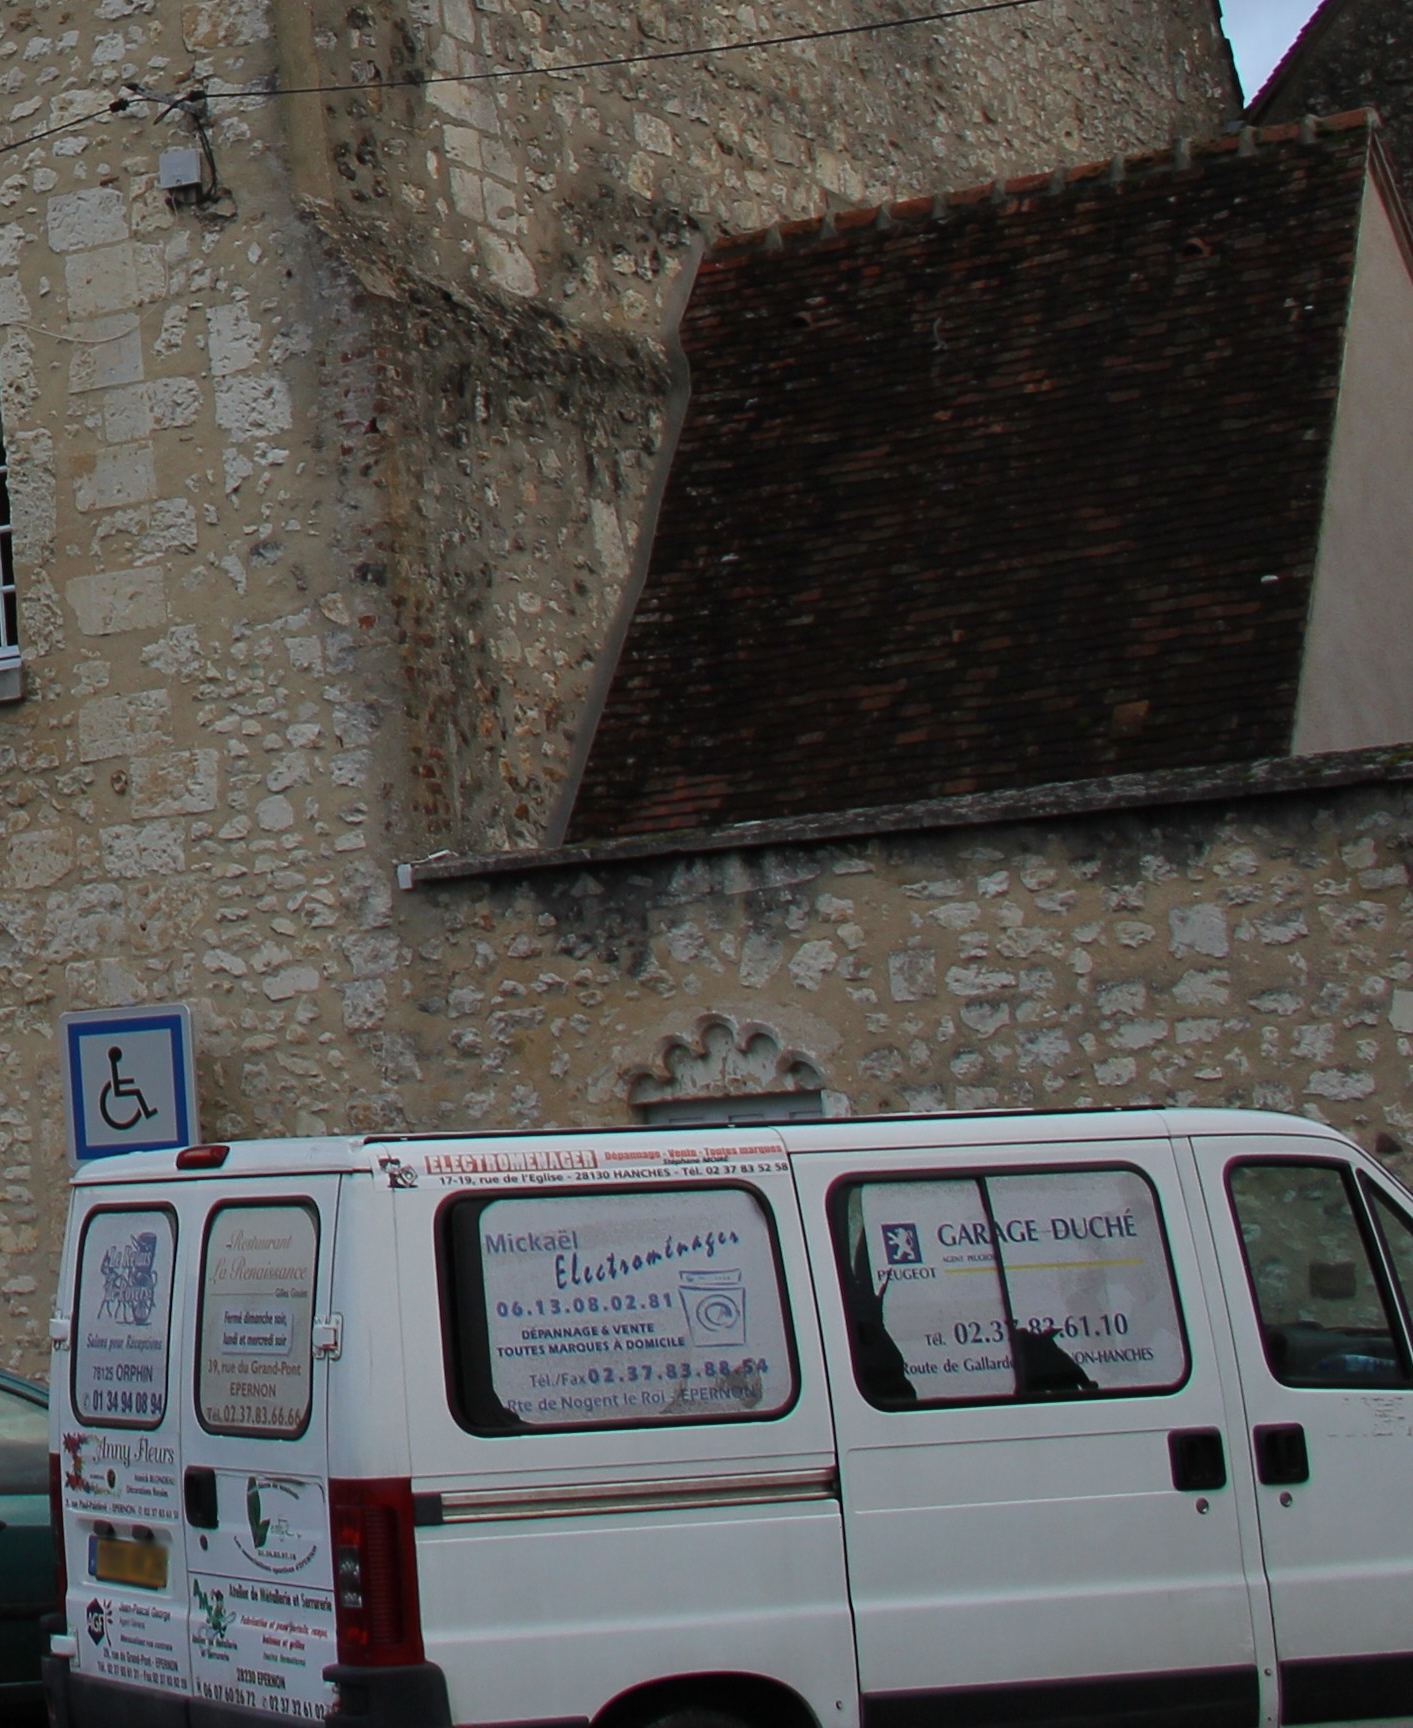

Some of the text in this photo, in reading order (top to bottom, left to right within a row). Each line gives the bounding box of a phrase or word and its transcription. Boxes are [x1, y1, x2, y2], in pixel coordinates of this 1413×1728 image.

[668, 1147, 697, 1157] Vente
[704, 1146, 737, 1156] Toutes
[739, 1145, 783, 1154] marques
[427, 1151, 596, 1174] ELECTROMENAGER
[439, 1161, 788, 1186] 17-19, rue de l'Eglise 28130 HANCHES Tél. 02 37 83 52 58
[1050, 1207, 1137, 1241] DUCHÉ
[228, 1229, 292, 1251] Restaurant
[485, 1229, 578, 1254] Mickaël
[229, 1256, 308, 1282] Renaissance
[496, 1292, 673, 1318] 06.13.08.02.81
[224, 1310, 242, 1323] Fermé
[244, 1311, 273, 1324] dimanche
[223, 1333, 287, 1347] lundi et mercredi soir
[522, 1322, 654, 1340] DÉPANNAGE & VENTE
[924, 1332, 946, 1347] Tél.
[496, 1345, 545, 1358] TOUTES
[548, 1341, 610, 1354] MARQUES
[626, 1336, 685, 1349] DOMICILE
[115, 1364, 153, 1382] ORPHIN
[222, 1362, 239, 1373] rue
[240, 1360, 249, 1373] du
[250, 1359, 302, 1376] Grand-Pont
[943, 1358, 958, 1372] de
[230, 1382, 276, 1398] EPERNON
[507, 1385, 758, 1413] Rte de Nogent le Roi EPERNON
[92, 1391, 162, 1415] 01 34 94 08 94
[223, 1405, 301, 1426] 02.37.83.66.66
[134, 1436, 175, 1465] Fleurs
[87, 1612, 103, 1633] AGF
[257, 1671, 286, 1690] EPERNON
[202, 1683, 212, 1698] 06
[213, 1684, 222, 1700] 07
[224, 1686, 234, 1702] 60
[236, 1688, 245, 1704] 26
[247, 1690, 256, 1706] 72
[269, 1694, 279, 1711] 02
[281, 1696, 289, 1713] 37
[292, 1698, 302, 1715] 32
[303, 1701, 313, 1718] 61
